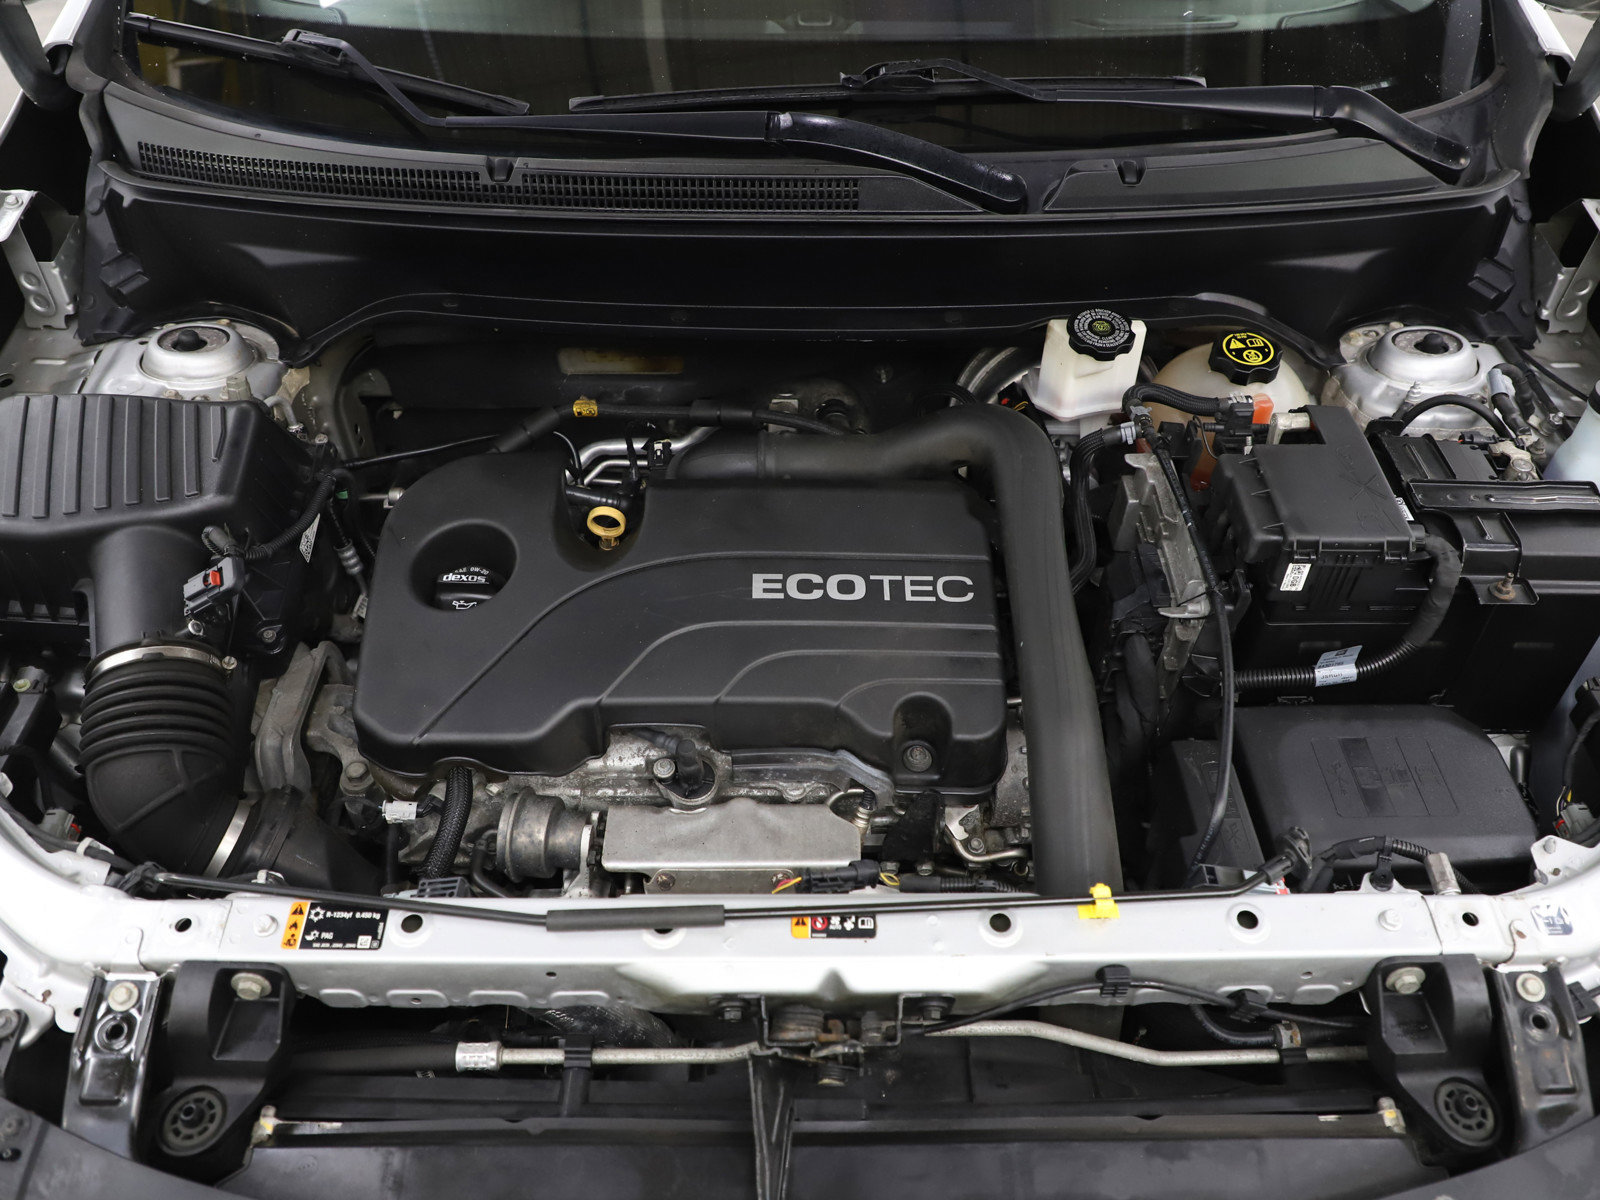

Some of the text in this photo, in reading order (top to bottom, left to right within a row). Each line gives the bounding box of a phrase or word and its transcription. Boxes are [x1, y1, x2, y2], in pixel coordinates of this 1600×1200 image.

[470, 567, 489, 575] 0W-20
[443, 573, 486, 583] dexos
[752, 573, 974, 602] ECOTEC
[326, 911, 381, 920] R-1234yf 0.450 kg
